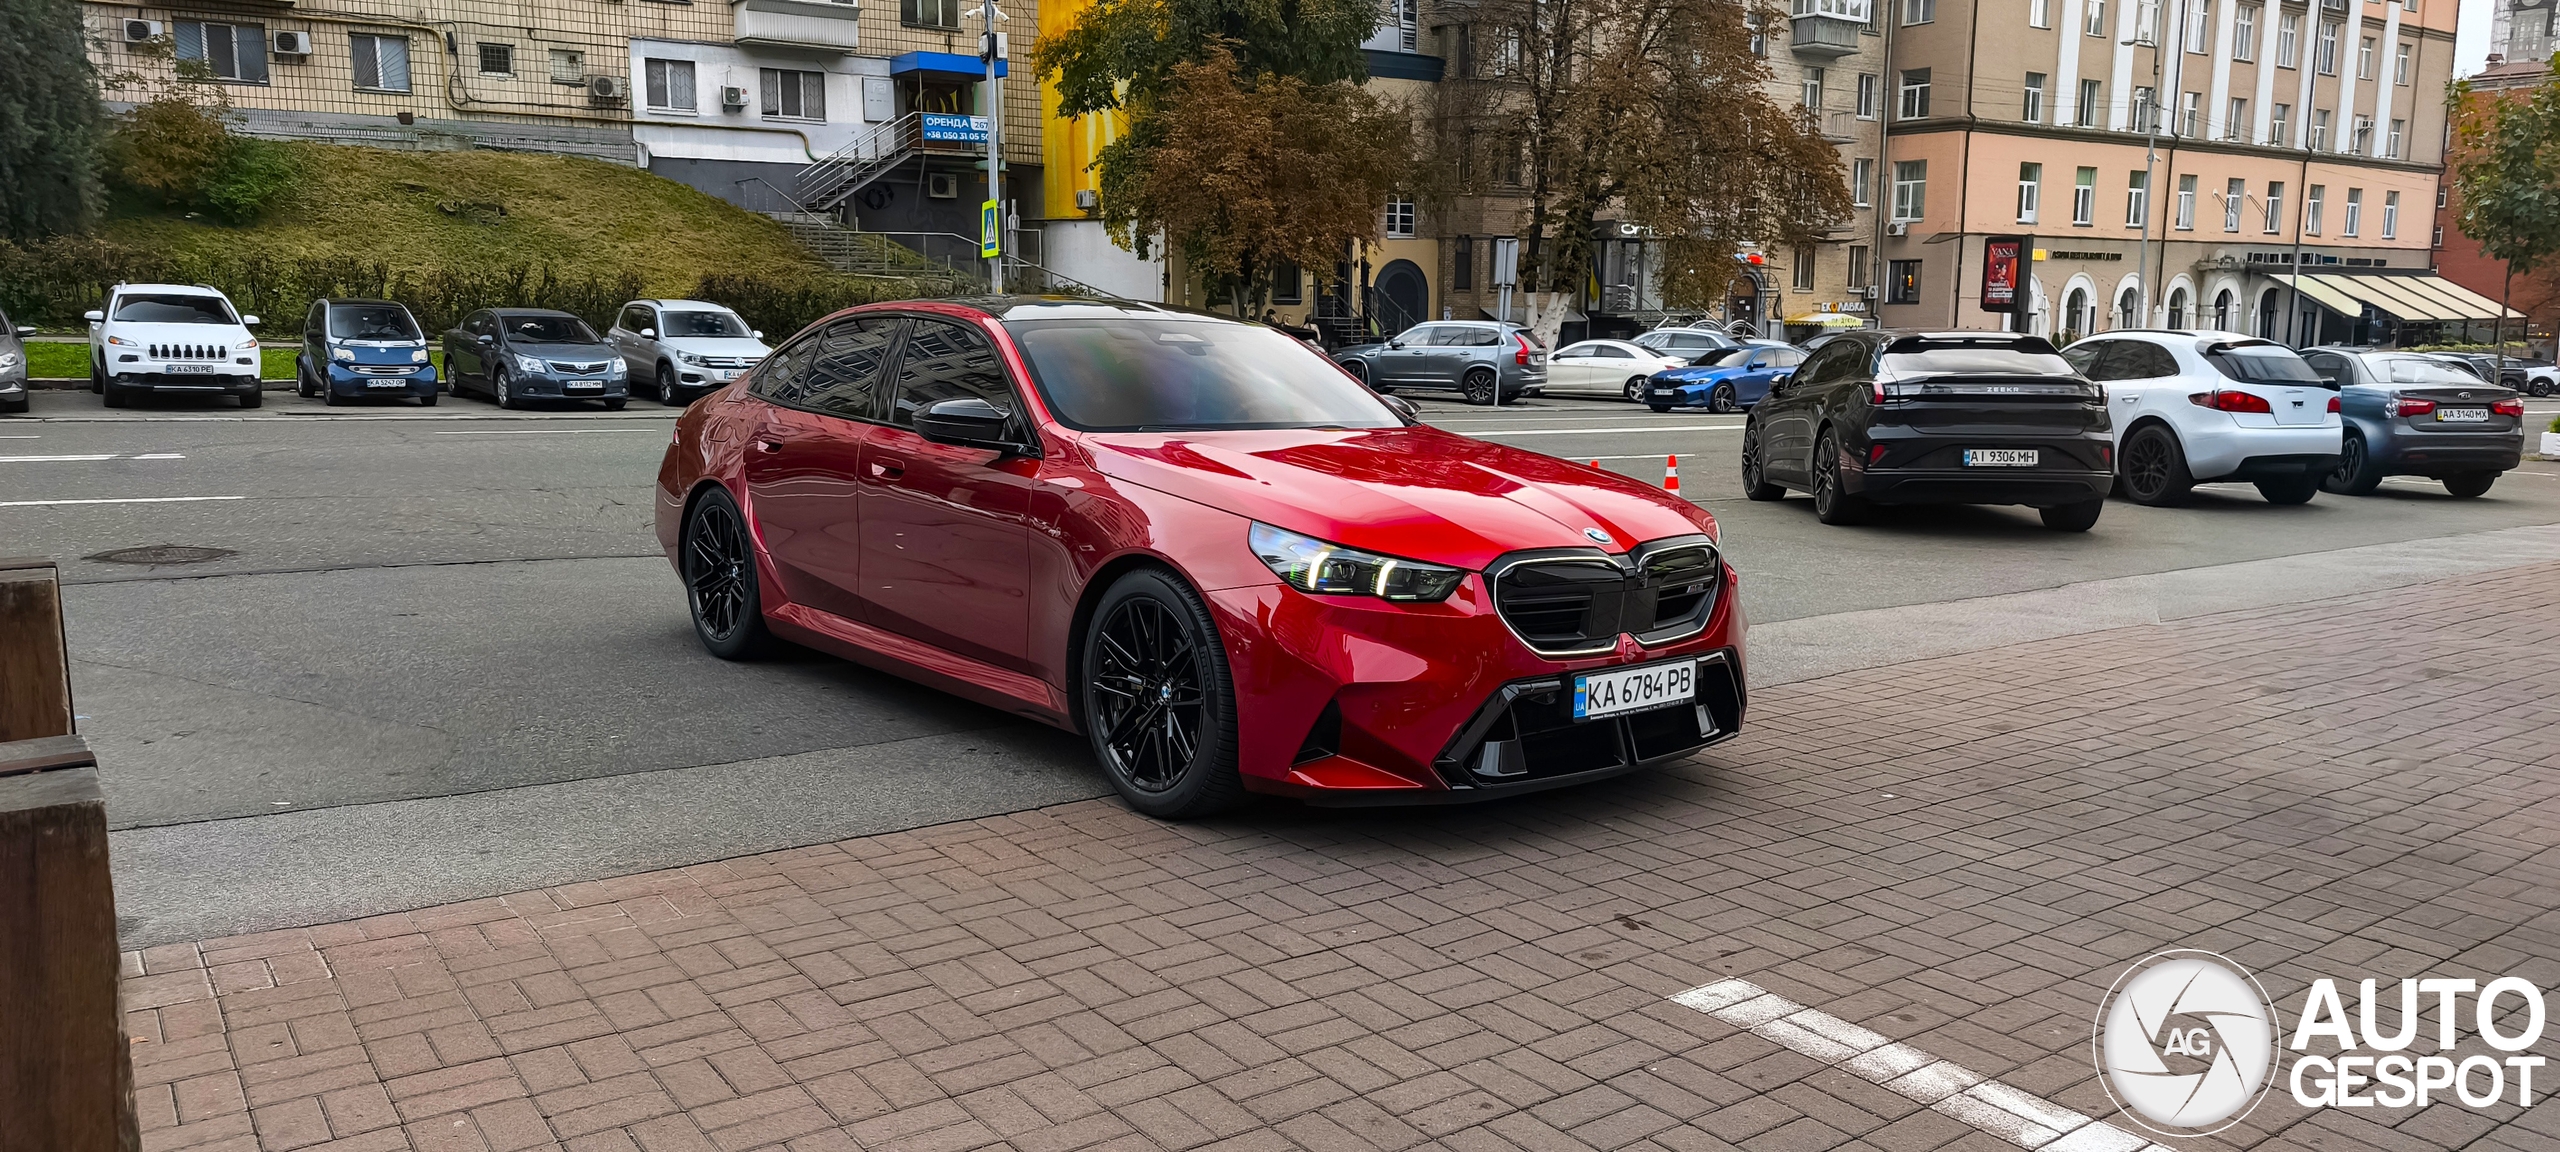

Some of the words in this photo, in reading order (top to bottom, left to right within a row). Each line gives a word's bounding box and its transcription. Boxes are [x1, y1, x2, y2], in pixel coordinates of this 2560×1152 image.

[926, 117, 969, 129] ОРЕНДА
[926, 130, 941, 139] +38
[942, 131, 958, 139] 050
[959, 132, 967, 140] 31
[969, 132, 980, 140] 05
[1991, 247, 2014, 256] YANA
[2443, 410, 2455, 419] AA
[2457, 410, 2474, 419] 3140
[2476, 410, 2487, 419] MX
[1971, 450, 1984, 462] AI
[1990, 450, 2016, 463] 9306
[2018, 451, 2035, 463] MH
[1588, 680, 1616, 710] KA
[1622, 671, 1663, 703] 6784
[1667, 666, 1691, 696] PB
[1575, 702, 1585, 712] UA
